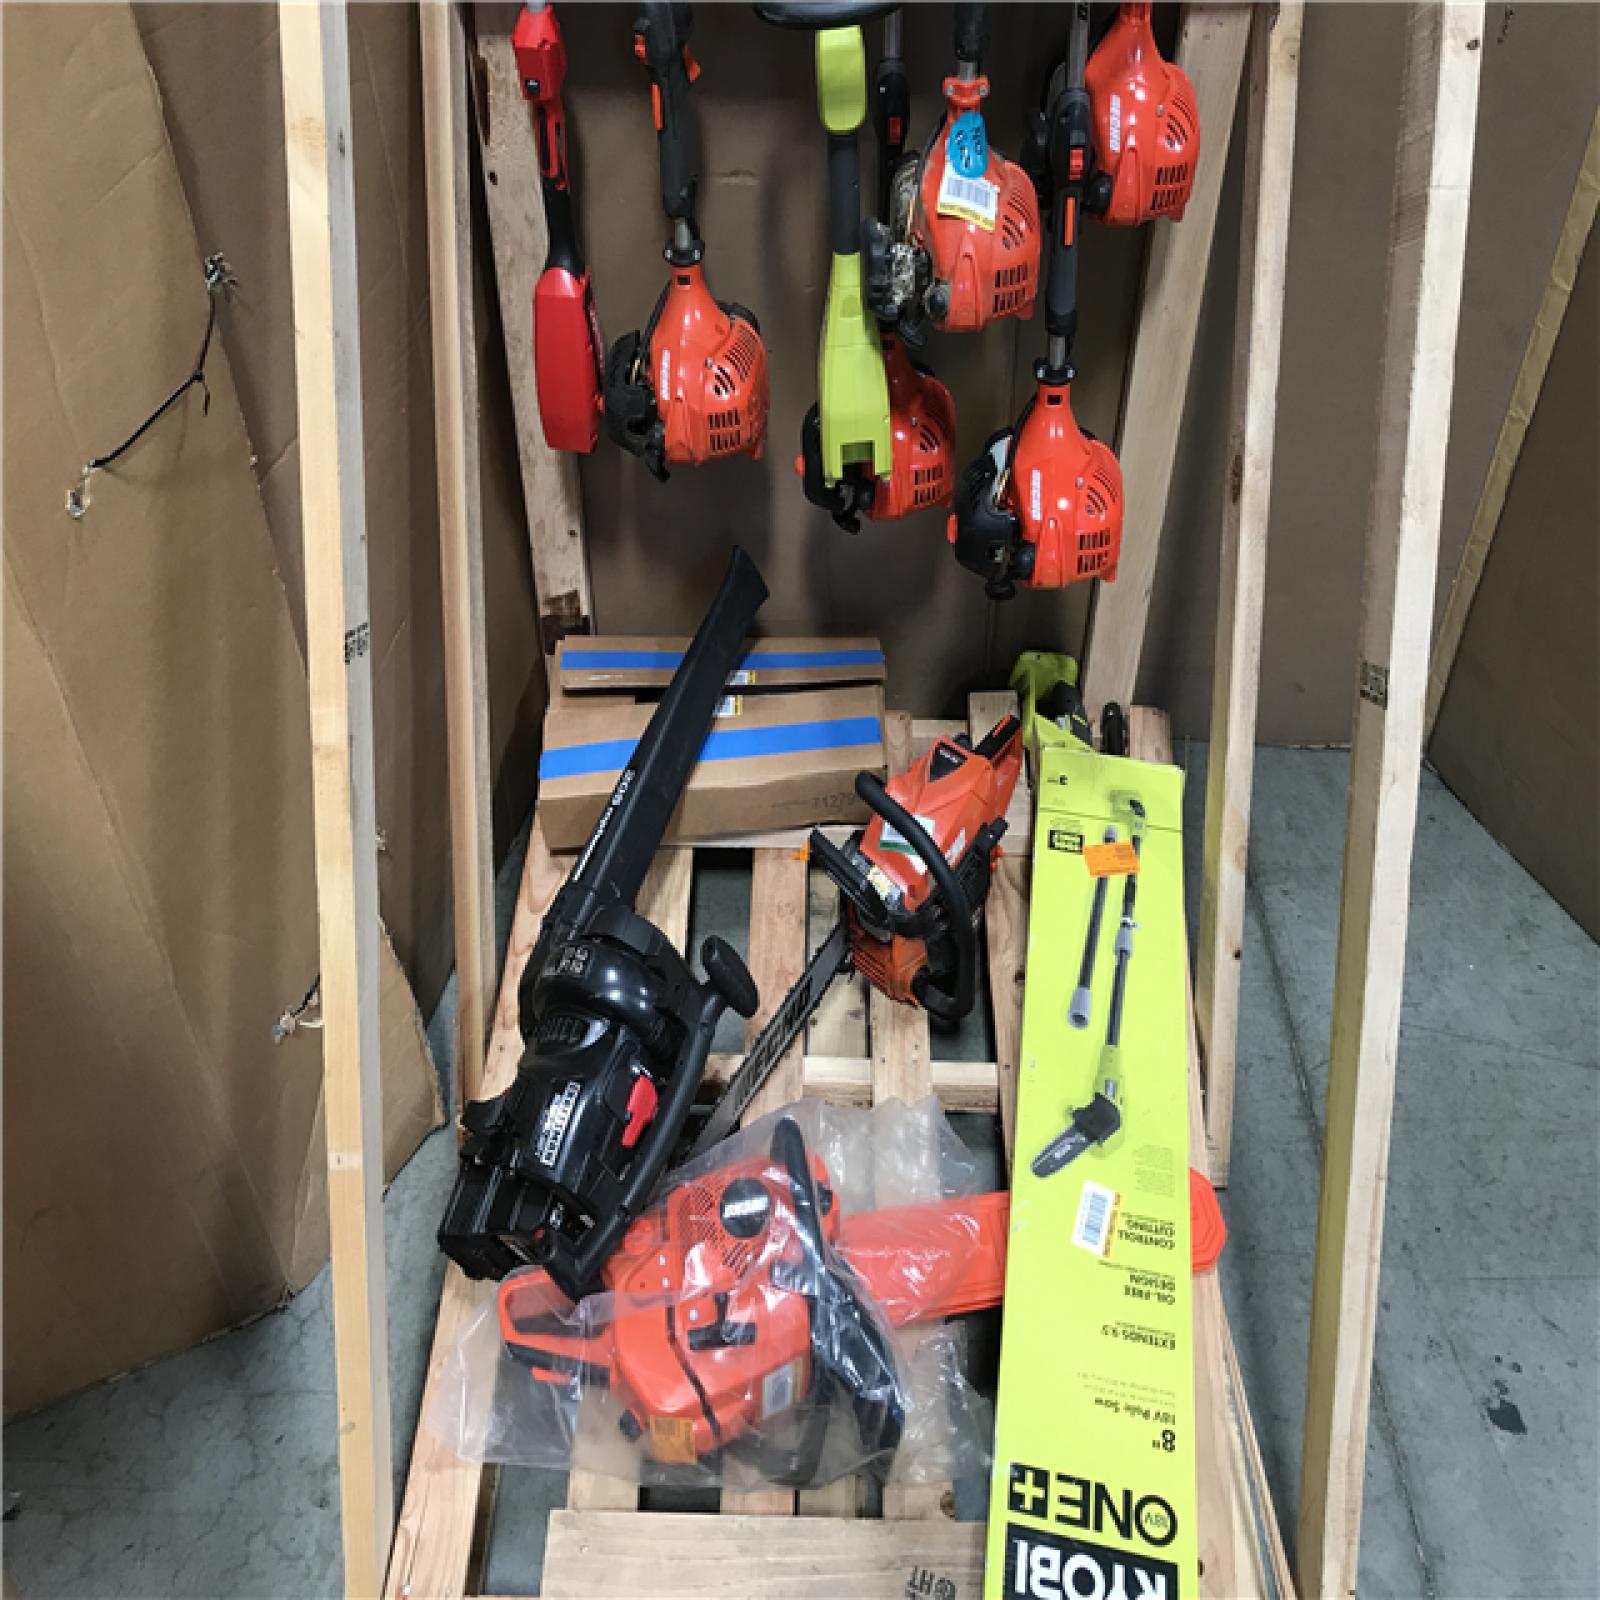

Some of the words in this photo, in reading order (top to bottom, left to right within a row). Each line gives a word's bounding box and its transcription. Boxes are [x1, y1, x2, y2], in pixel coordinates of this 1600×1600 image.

[1130, 1274, 1175, 1291] DESIGN
[1122, 1329, 1175, 1350] EXTENDS
[1094, 1397, 1120, 1413] Saw
[1123, 1402, 1151, 1420] Pole
